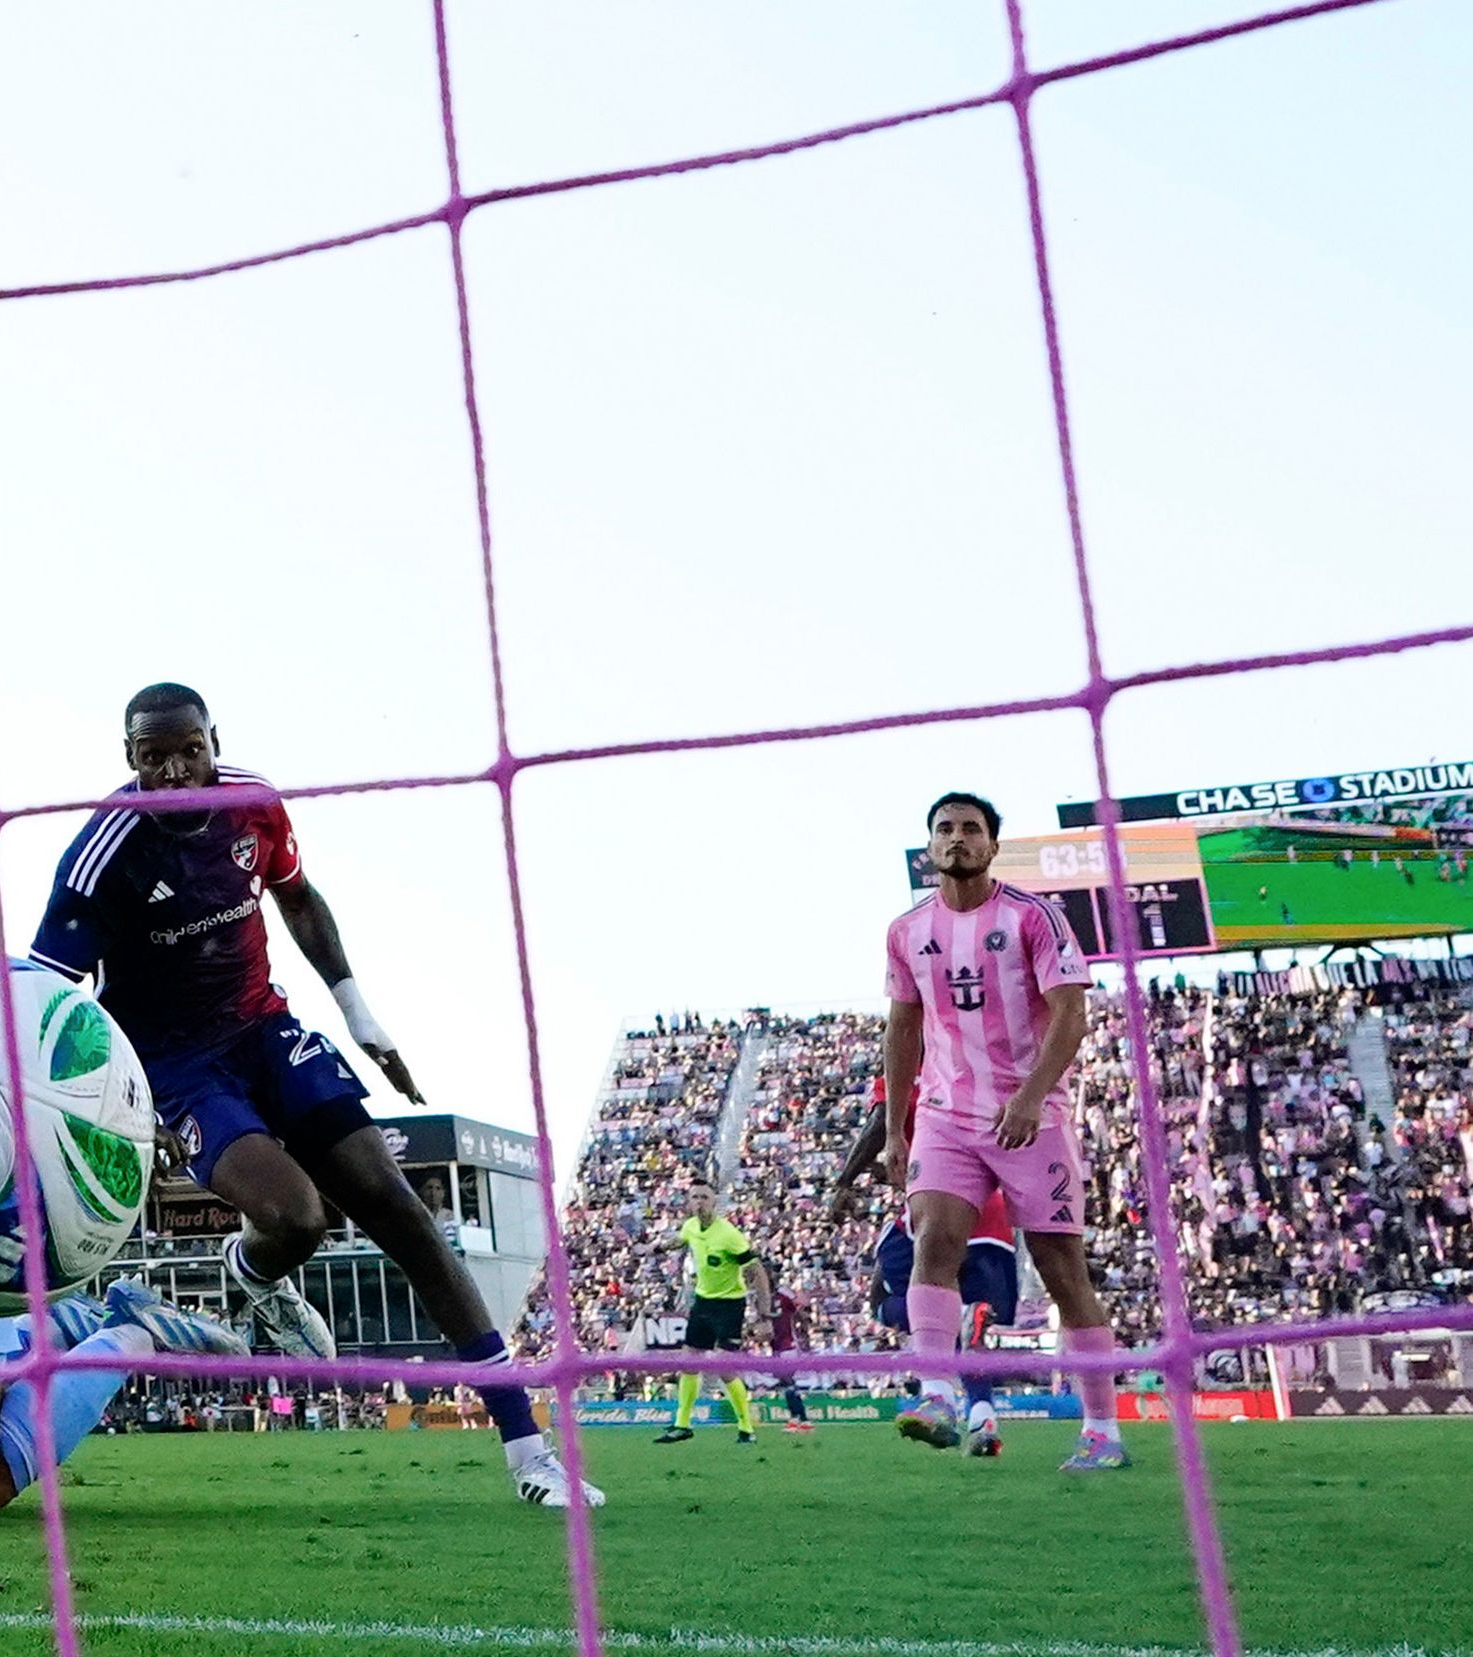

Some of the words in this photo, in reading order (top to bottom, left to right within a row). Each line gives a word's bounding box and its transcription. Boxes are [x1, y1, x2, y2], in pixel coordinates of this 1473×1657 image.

[1176, 781, 1300, 815] CHASE
[1338, 763, 1473, 799] STADIUM
[1125, 884, 1178, 902] DAL
[1048, 1162, 1072, 1202] 2
[164, 1208, 205, 1227] Hard
